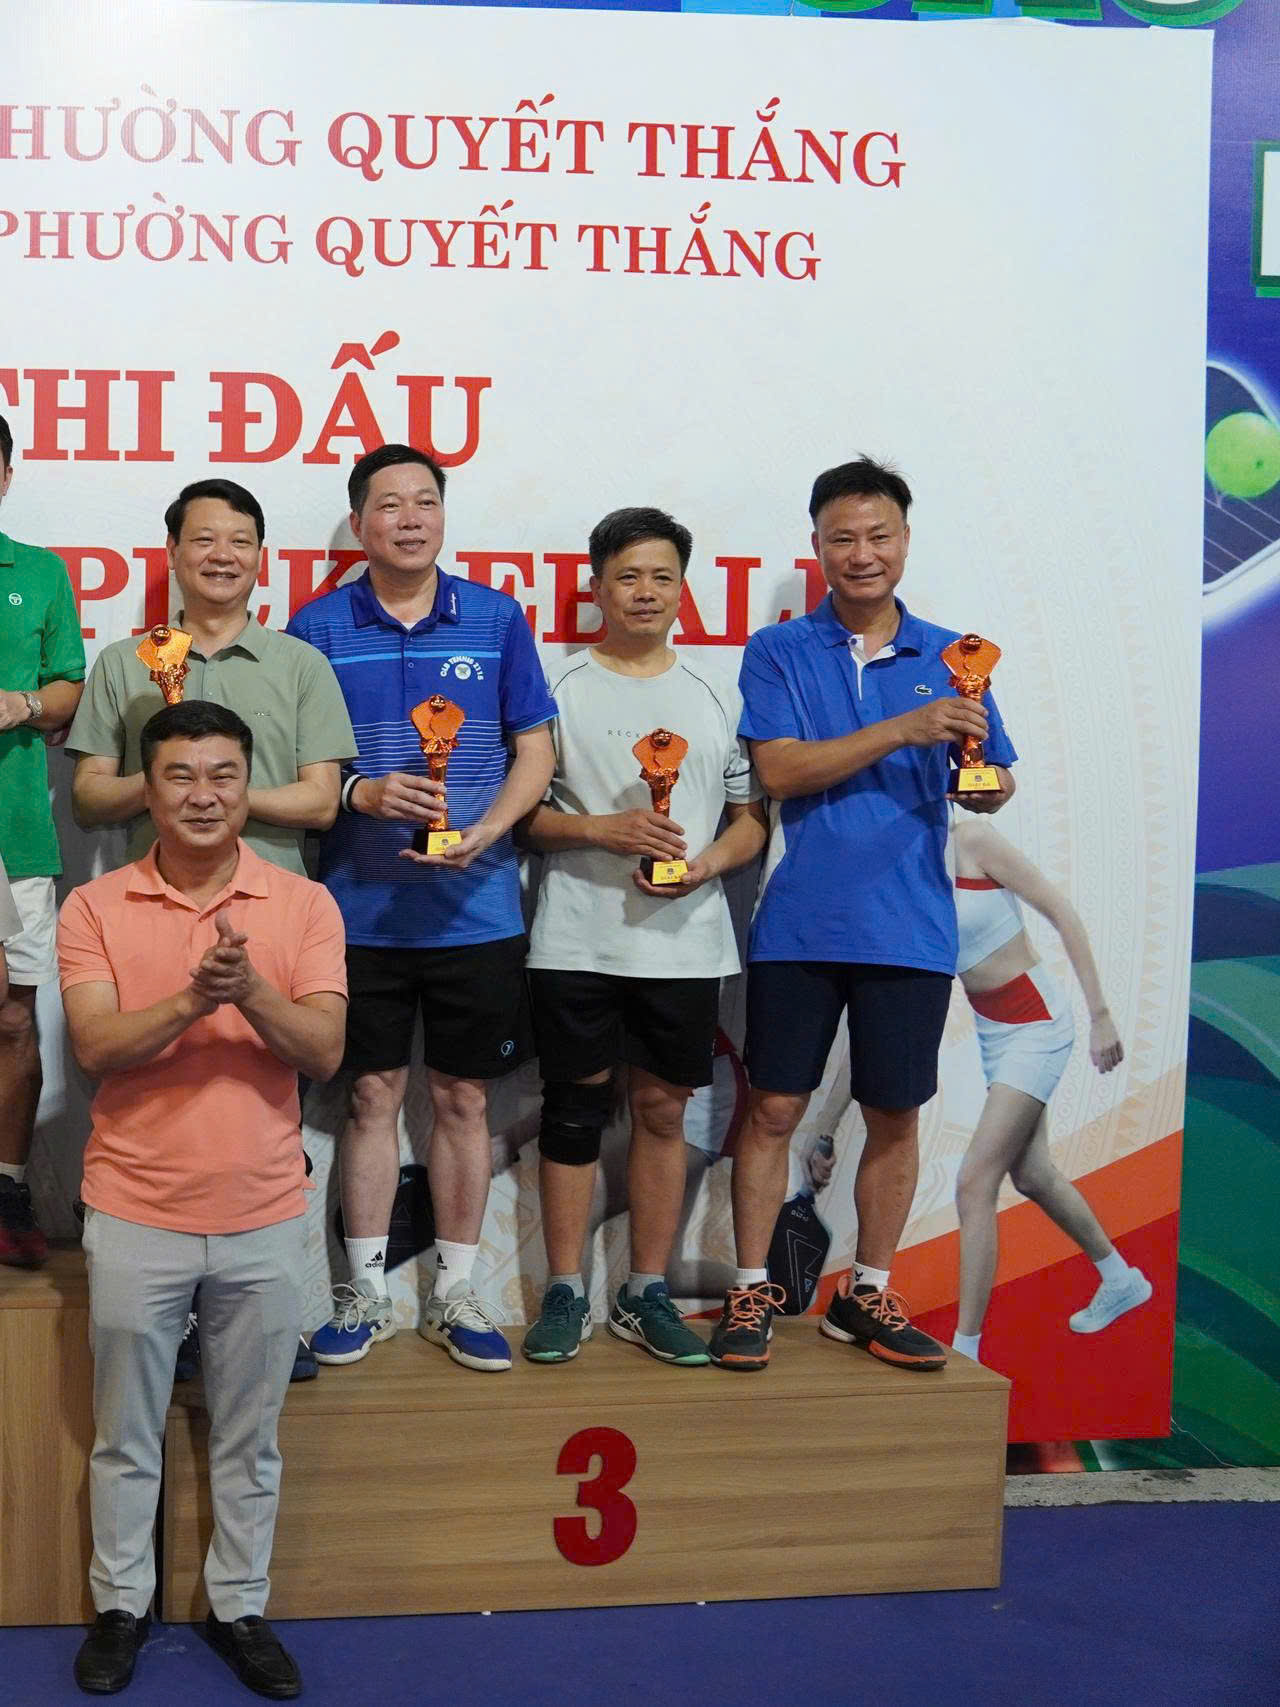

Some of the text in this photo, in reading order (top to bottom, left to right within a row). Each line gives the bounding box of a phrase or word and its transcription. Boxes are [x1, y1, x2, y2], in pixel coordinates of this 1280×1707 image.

[328, 92, 605, 182] QUYẾT
[628, 96, 906, 188] THẮNG
[315, 199, 558, 279] QUYẾT
[577, 201, 822, 281] THẮNG
[208, 330, 492, 468] ĐẤU
[553, 1427, 638, 1567] 3
